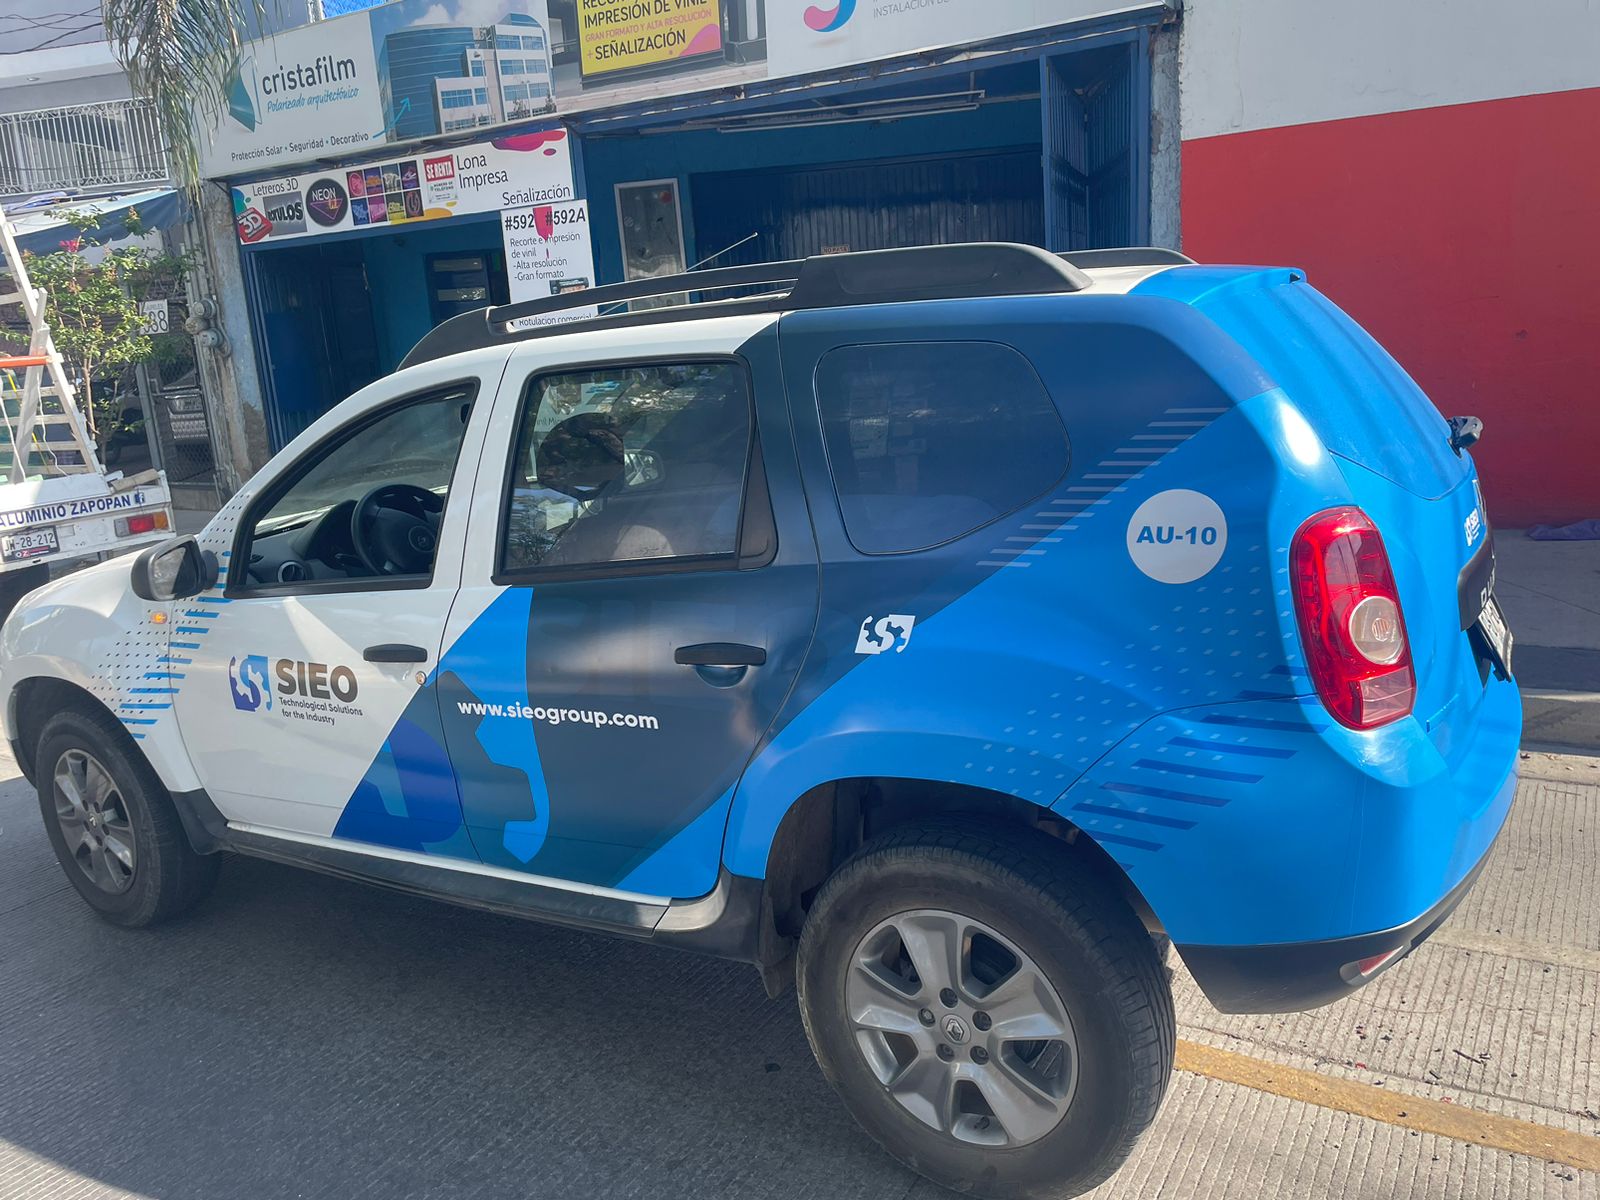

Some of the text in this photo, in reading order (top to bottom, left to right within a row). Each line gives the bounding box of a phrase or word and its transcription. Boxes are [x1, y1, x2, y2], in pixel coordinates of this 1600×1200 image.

[584, 0, 650, 28] IMPRESIÓN
[654, 0, 670, 14] DE
[585, 32, 605, 42] GRAN
[606, 26, 639, 38] FORMATO
[647, 21, 663, 31] ALTA
[595, 28, 686, 60] SEÑALIZACIÓN
[262, 55, 356, 95] cristafilm
[267, 93, 305, 112] Polarizado
[231, 132, 369, 161] Protección Solar Seguridad Decorativo
[426, 161, 453, 179] SE RENTA
[457, 155, 487, 170] Lona
[252, 178, 298, 197] Letreros 3D
[459, 170, 508, 191] Impresa
[312, 187, 336, 201] NEON
[502, 184, 570, 206] Señalización
[238, 212, 262, 235] 3D
[505, 208, 586, 231] #592 #592A
[510, 237, 537, 247] Recorte
[511, 247, 536, 258] de vinil
[532, 257, 567, 268] resolución
[536, 270, 564, 279] formato
[71, 495, 131, 516] ZAPOPAN
[1136, 526, 1217, 545] AU-10
[276, 659, 358, 703] SIEO
[279, 697, 363, 716] Technological Solutions
[457, 701, 659, 730] www.sieogroup.com
[282, 708, 335, 726] for the Industry
